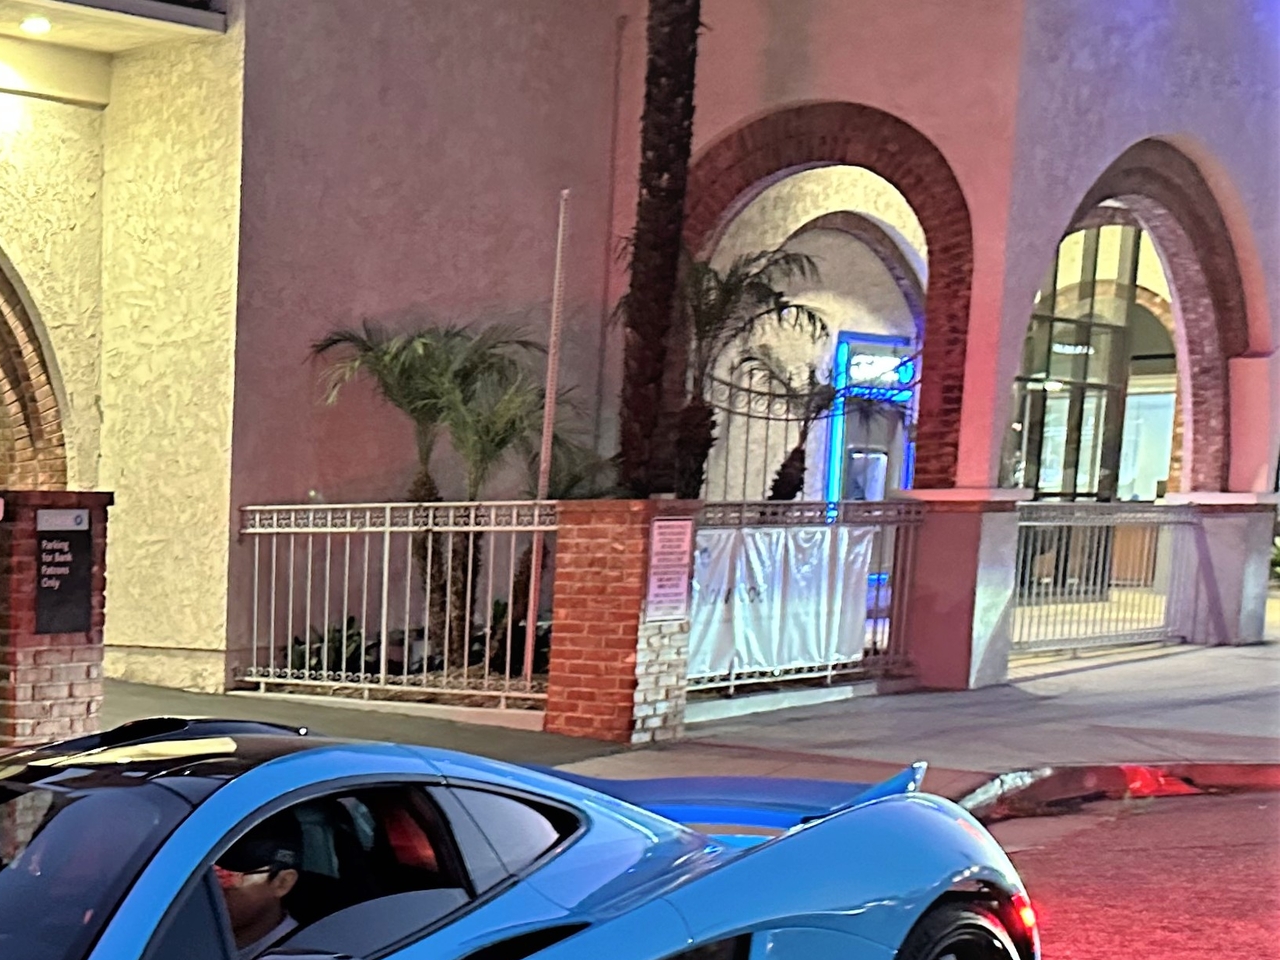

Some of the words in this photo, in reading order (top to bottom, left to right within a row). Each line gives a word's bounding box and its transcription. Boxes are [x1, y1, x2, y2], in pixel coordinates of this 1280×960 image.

[42, 540, 69, 552] Parking
[42, 553, 53, 562] for
[42, 565, 69, 575] Patrons
[41, 578, 60, 590] Only
